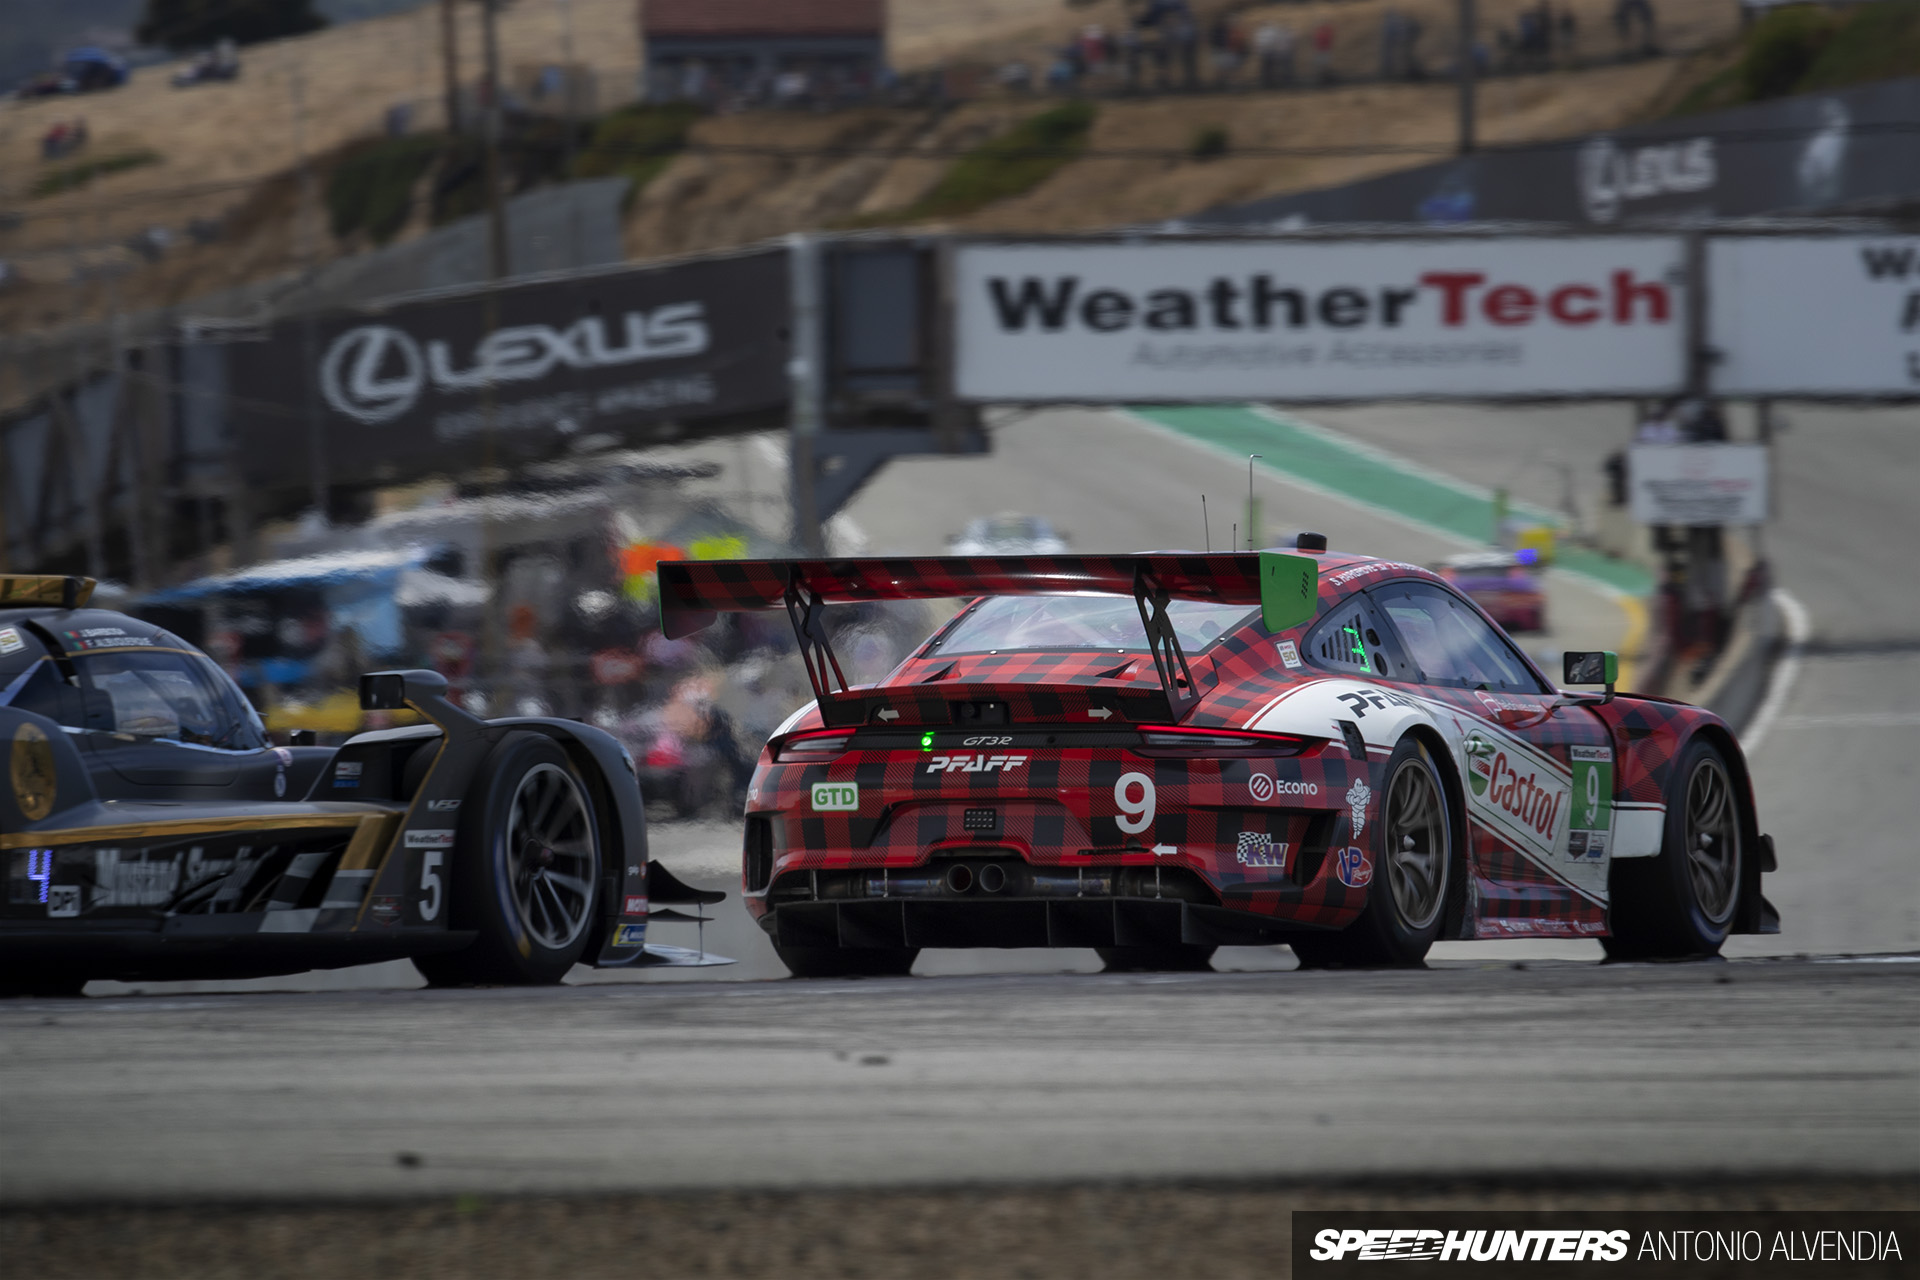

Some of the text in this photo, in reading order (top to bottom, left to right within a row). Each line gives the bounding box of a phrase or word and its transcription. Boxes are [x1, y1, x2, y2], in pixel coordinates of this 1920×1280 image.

[987, 269, 1673, 334] WeatherTech
[426, 302, 711, 390] LEXUS
[1133, 338, 1523, 371] Automotive Accessories
[1282, 650, 1297, 662] 50
[926, 754, 1028, 773] PFAFF
[1572, 748, 1610, 759] WeatherTech
[814, 787, 855, 806] GTD
[1113, 772, 1156, 834] 9
[1276, 780, 1318, 796] Econo
[1489, 751, 1562, 841] Castrol
[1585, 765, 1599, 826] 9
[1247, 844, 1289, 866] KW
[1338, 848, 1363, 886] VP
[27, 849, 53, 903] 4
[418, 851, 444, 922] 5
